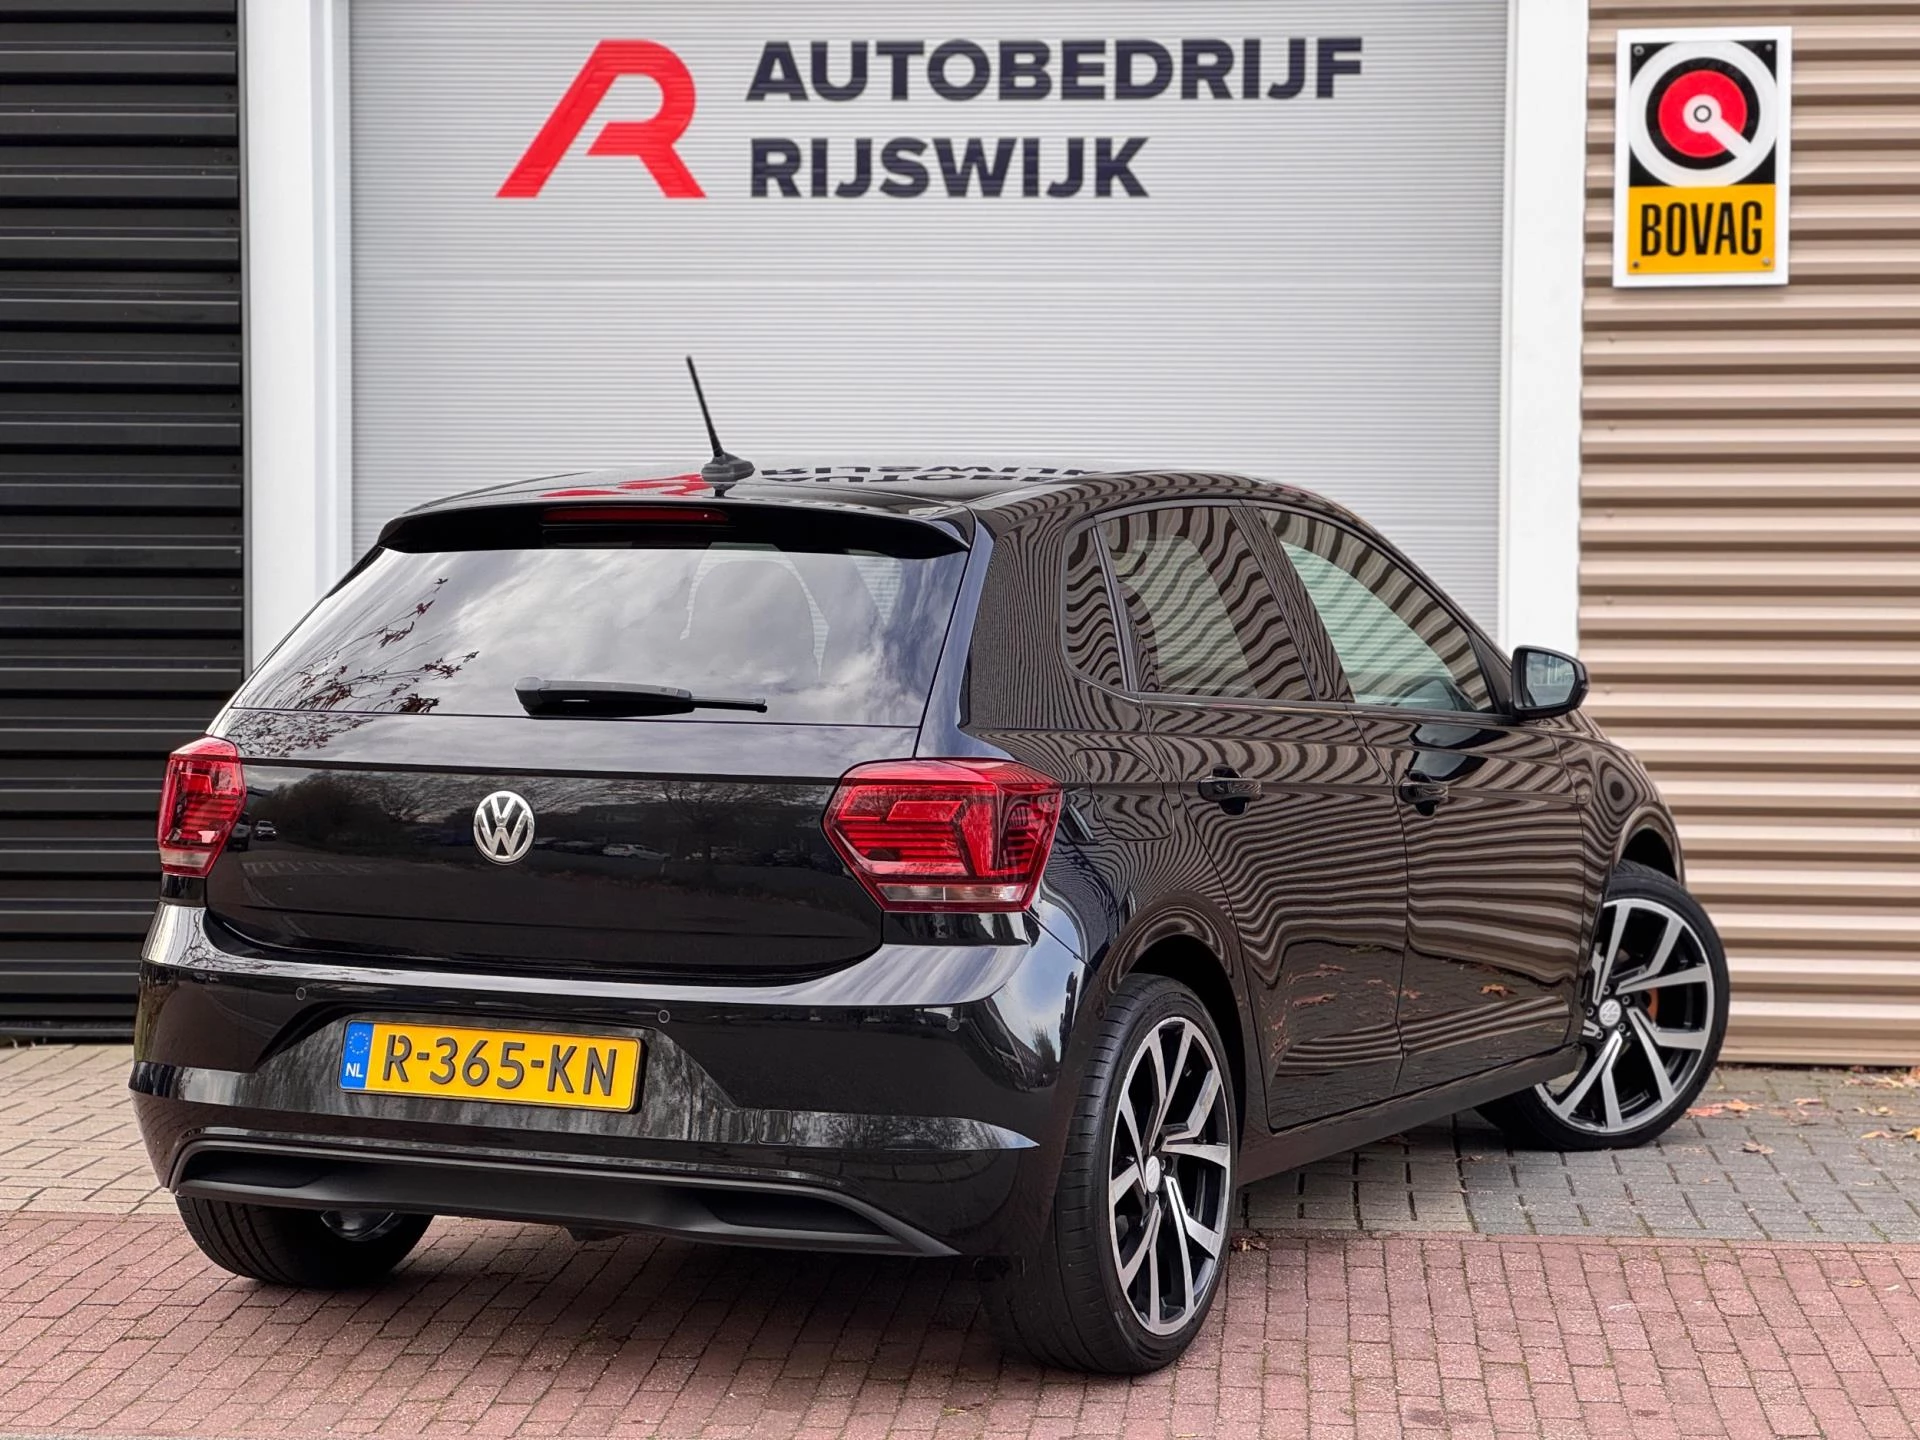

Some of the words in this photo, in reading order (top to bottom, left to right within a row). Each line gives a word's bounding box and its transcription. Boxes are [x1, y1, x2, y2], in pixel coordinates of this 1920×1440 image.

[746, 37, 1362, 101] AUTOBEDRIJF
[750, 136, 1150, 198] RIJSWIJK
[1640, 201, 1763, 256] BOVAG
[474, 791, 535, 862] VW
[345, 1062, 364, 1078] NL
[382, 1034, 617, 1097] R-365-KN
